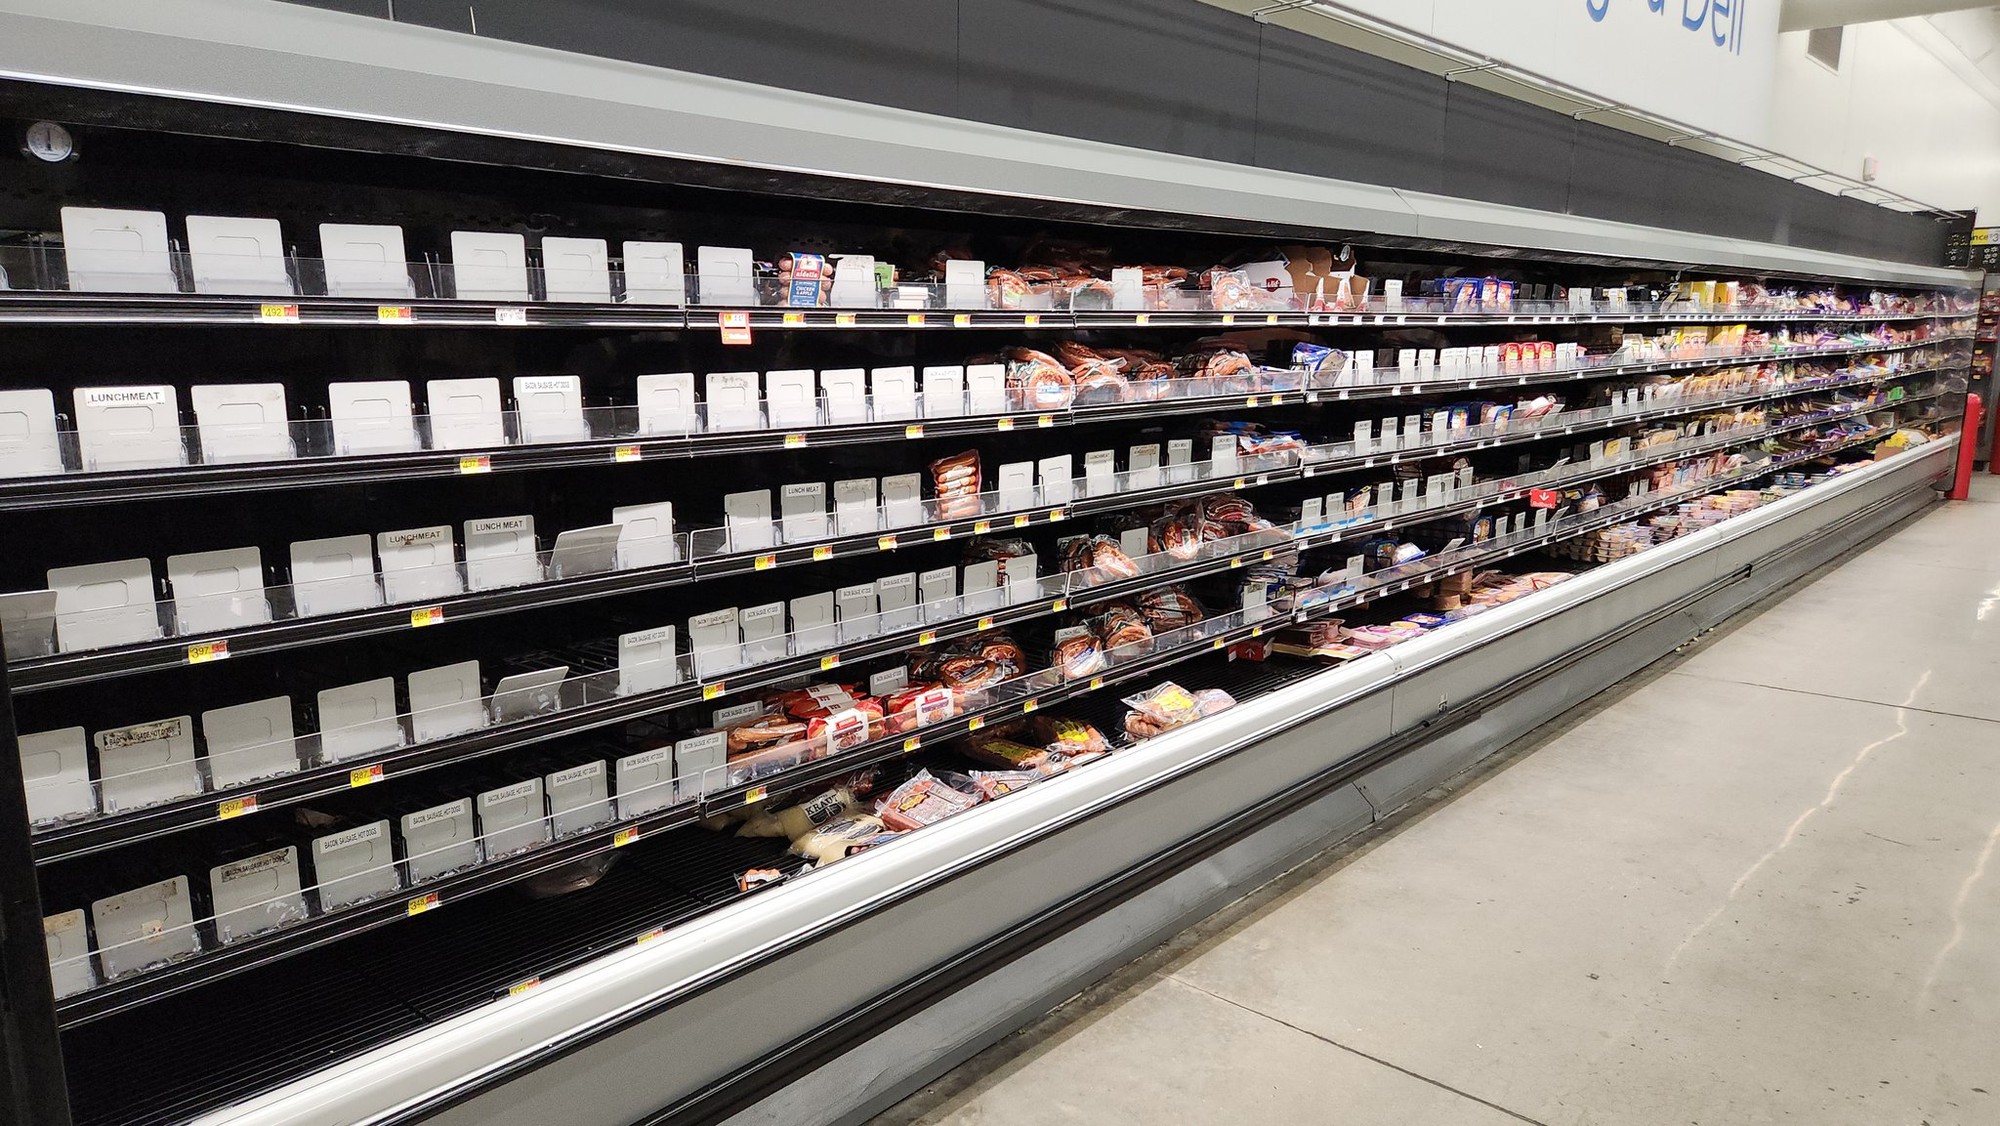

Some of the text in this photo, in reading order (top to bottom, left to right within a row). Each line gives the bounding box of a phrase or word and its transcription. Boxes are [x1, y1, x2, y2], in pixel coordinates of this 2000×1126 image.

[91, 392, 160, 402] LUNCHMEAT
[476, 520, 523, 532] LUNCH MEAT
[390, 531, 441, 543] LUNCHMEAT
[804, 793, 838, 815] KRAUT
